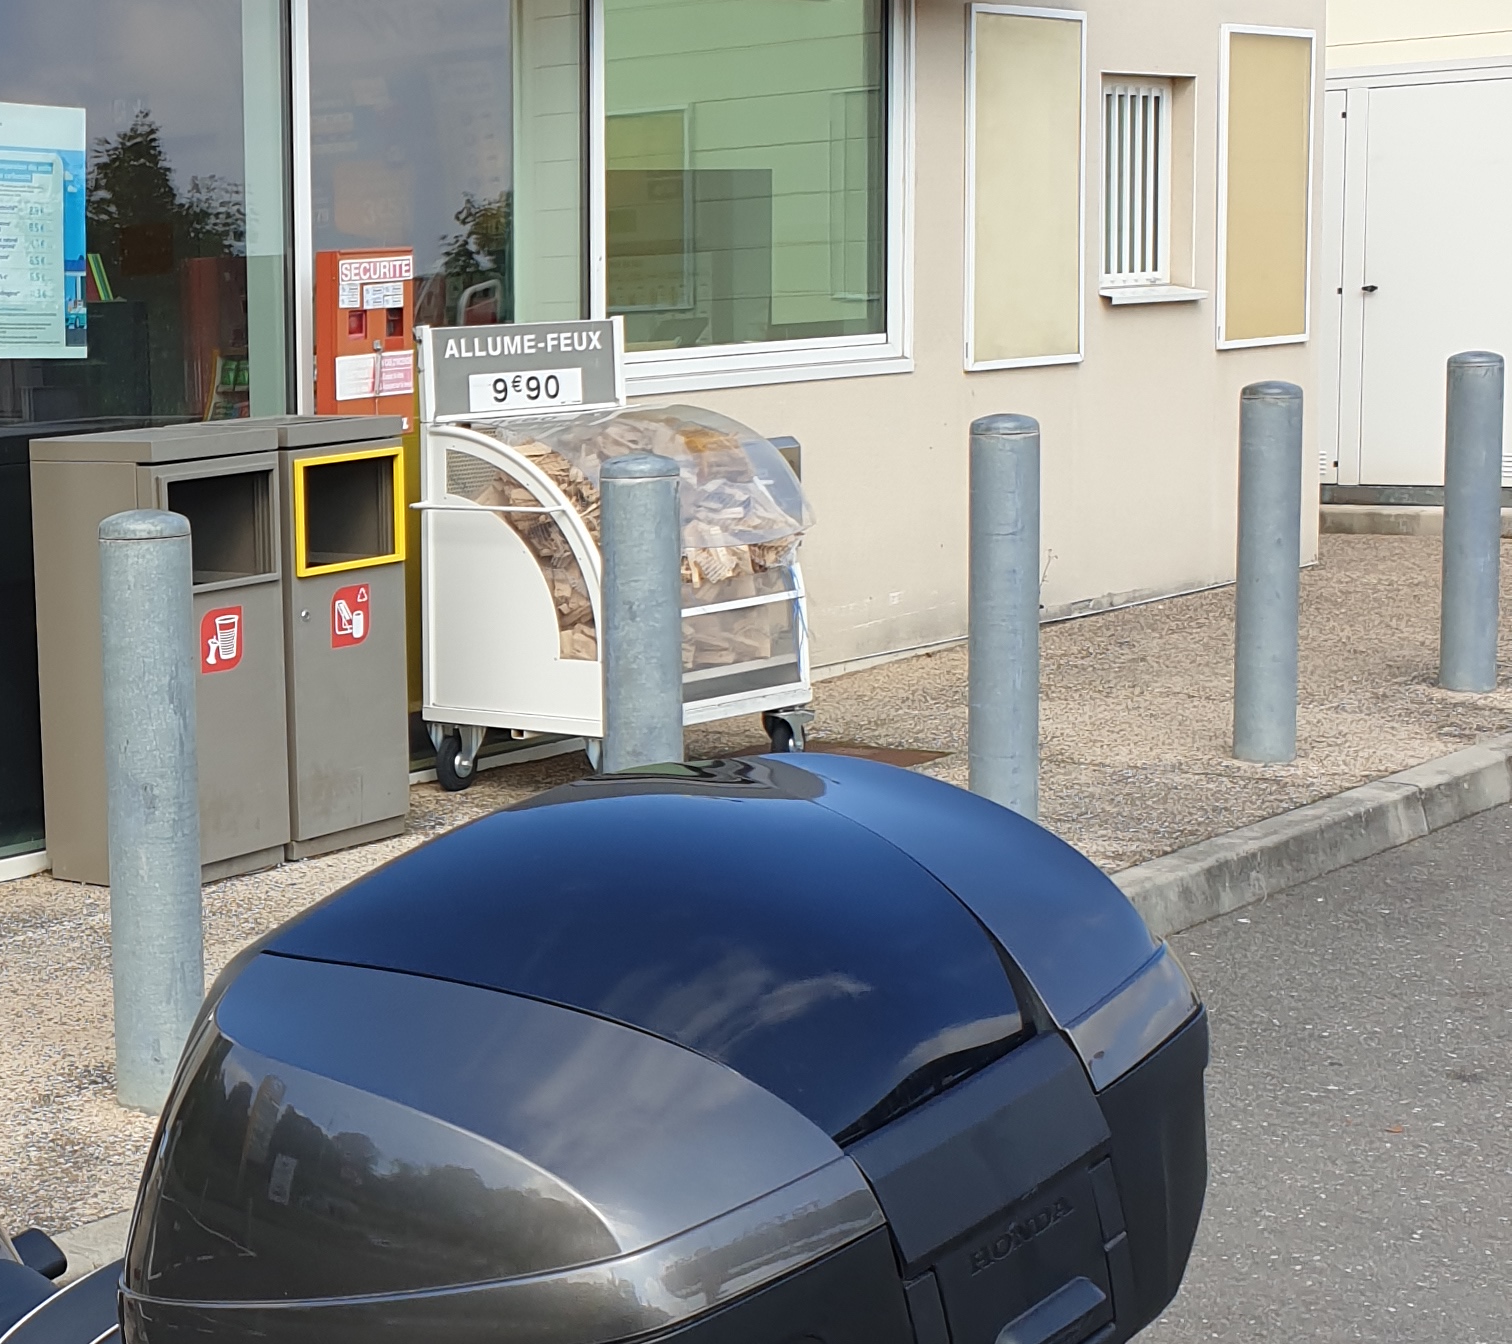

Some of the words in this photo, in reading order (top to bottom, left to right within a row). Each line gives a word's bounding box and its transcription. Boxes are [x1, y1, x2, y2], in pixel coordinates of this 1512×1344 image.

[341, 260, 411, 281] SECURITE
[444, 330, 602, 359] ALLUME-FEUX
[971, 1197, 1076, 1277] HONDA
